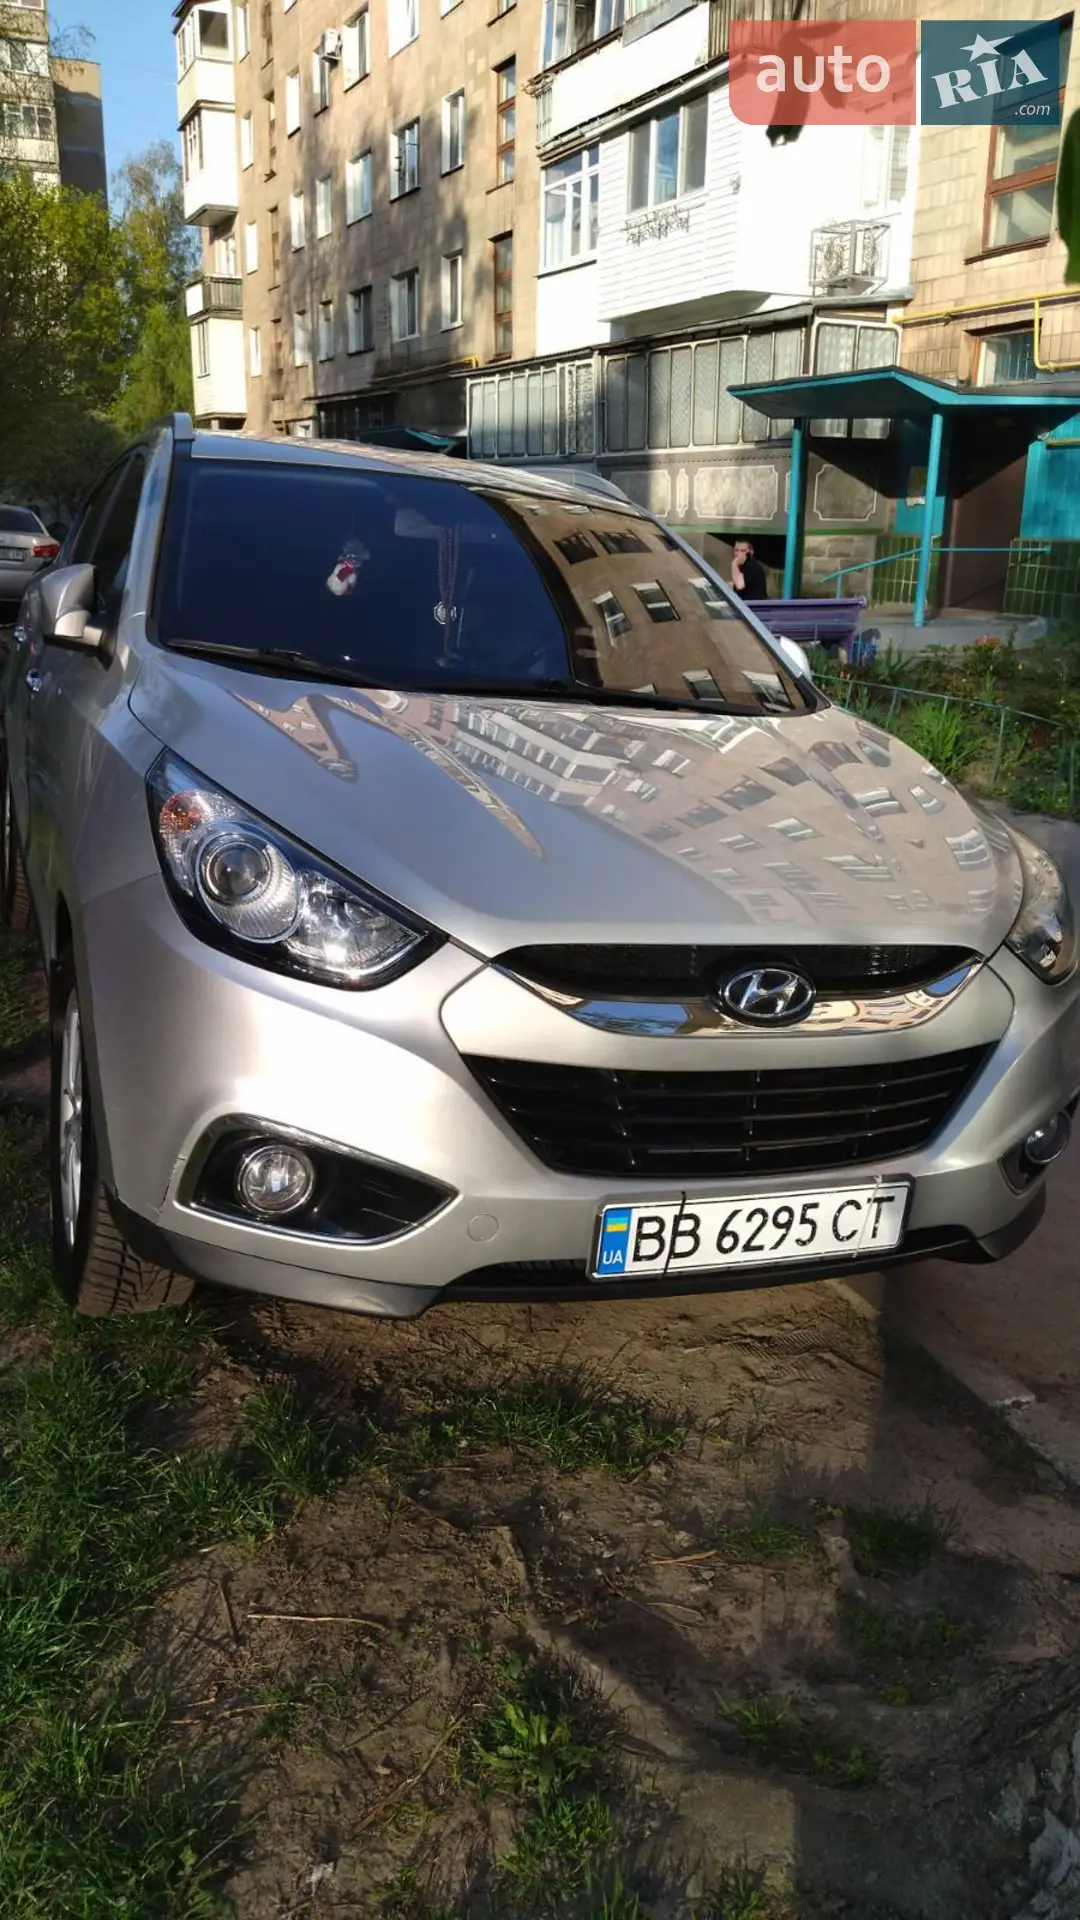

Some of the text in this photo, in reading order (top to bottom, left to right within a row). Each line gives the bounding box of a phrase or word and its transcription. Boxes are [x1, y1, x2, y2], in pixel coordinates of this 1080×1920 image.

[632, 1196, 896, 1263] BB 6295 CT
[602, 1250, 623, 1265] UA
